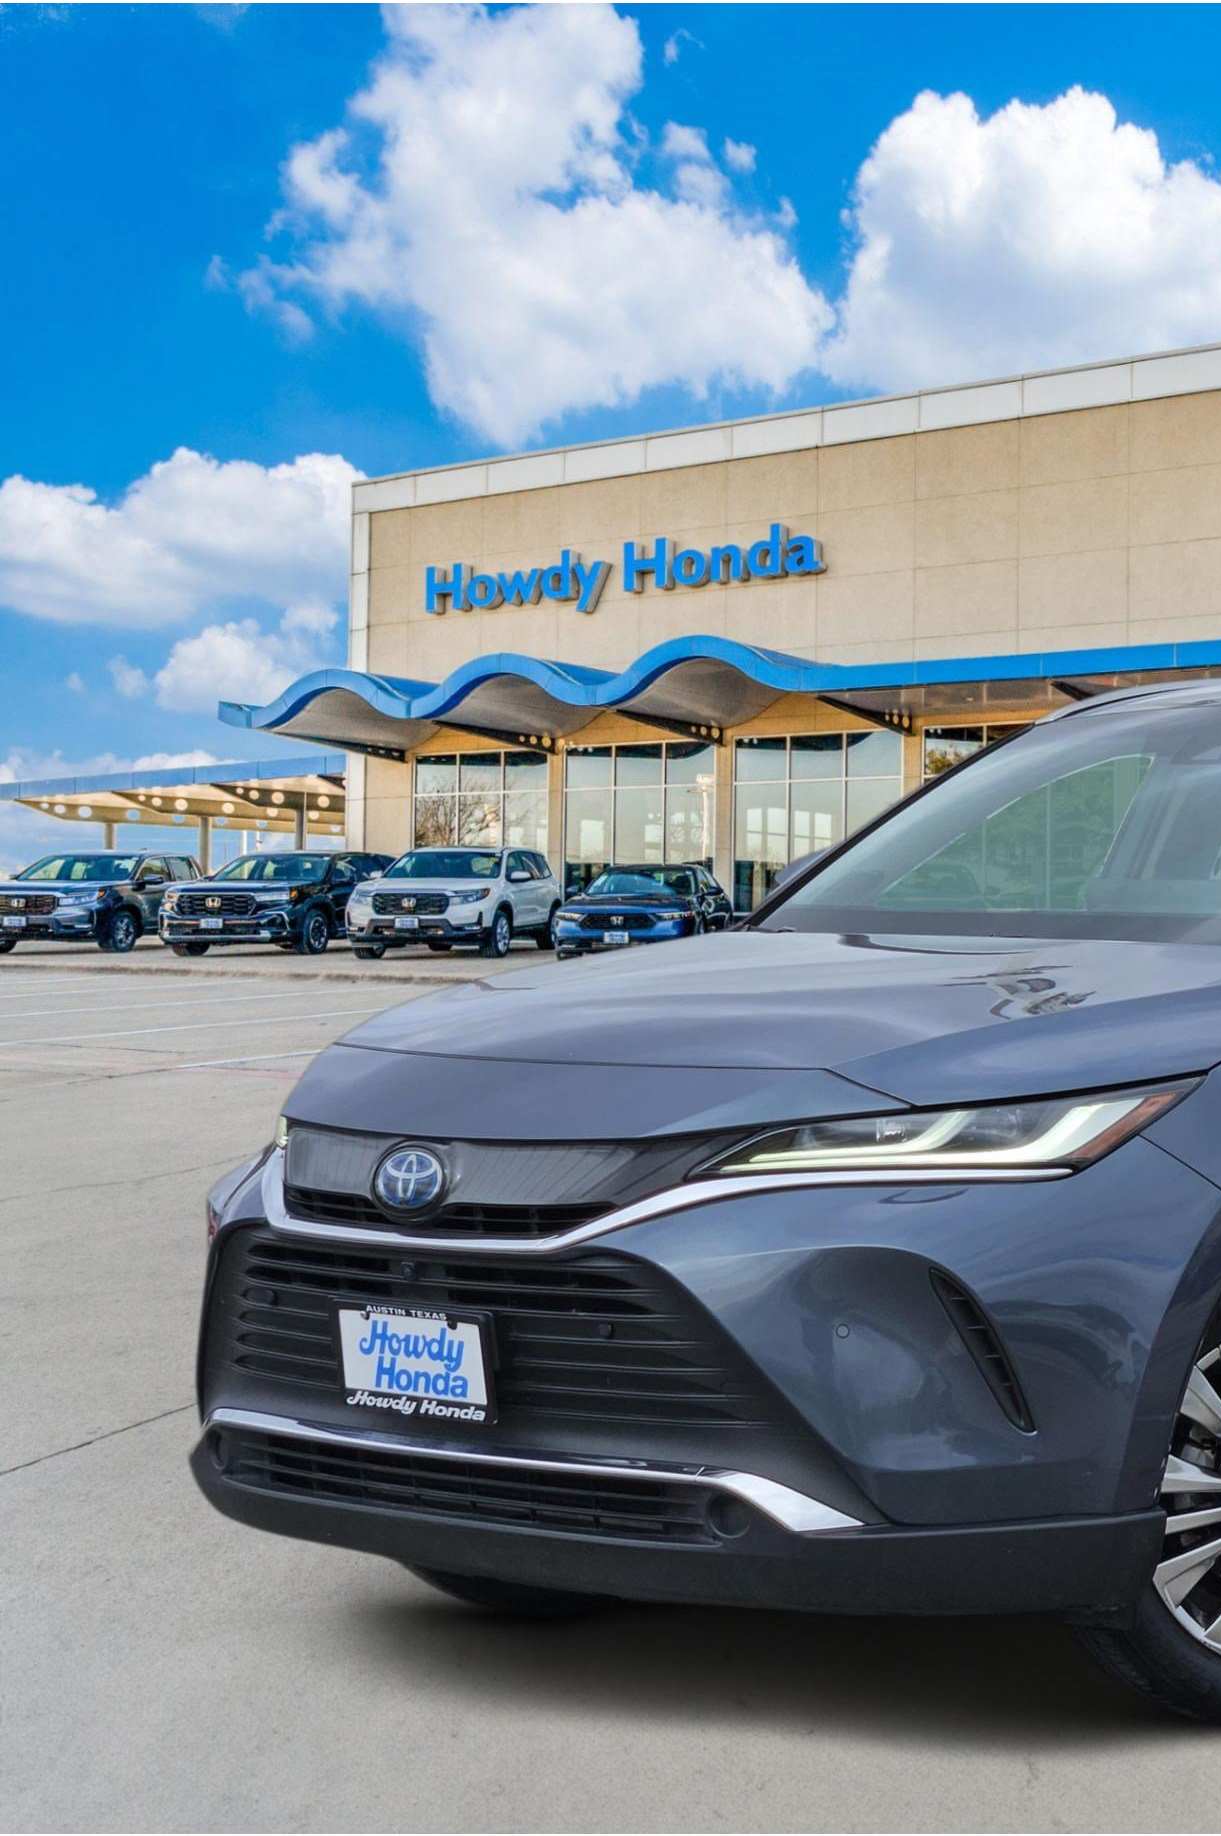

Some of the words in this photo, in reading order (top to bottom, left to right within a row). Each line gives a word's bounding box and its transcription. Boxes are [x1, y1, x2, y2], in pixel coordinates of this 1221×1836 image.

[425, 548, 613, 615] Howdy
[623, 523, 827, 594] Honda
[366, 1304, 406, 1316] AUSTIN
[409, 1309, 447, 1321] TEXAS
[359, 1319, 465, 1373] Howdy
[375, 1356, 469, 1398] Honda
[346, 1390, 417, 1415] Howdy
[420, 1399, 486, 1422] Honda
